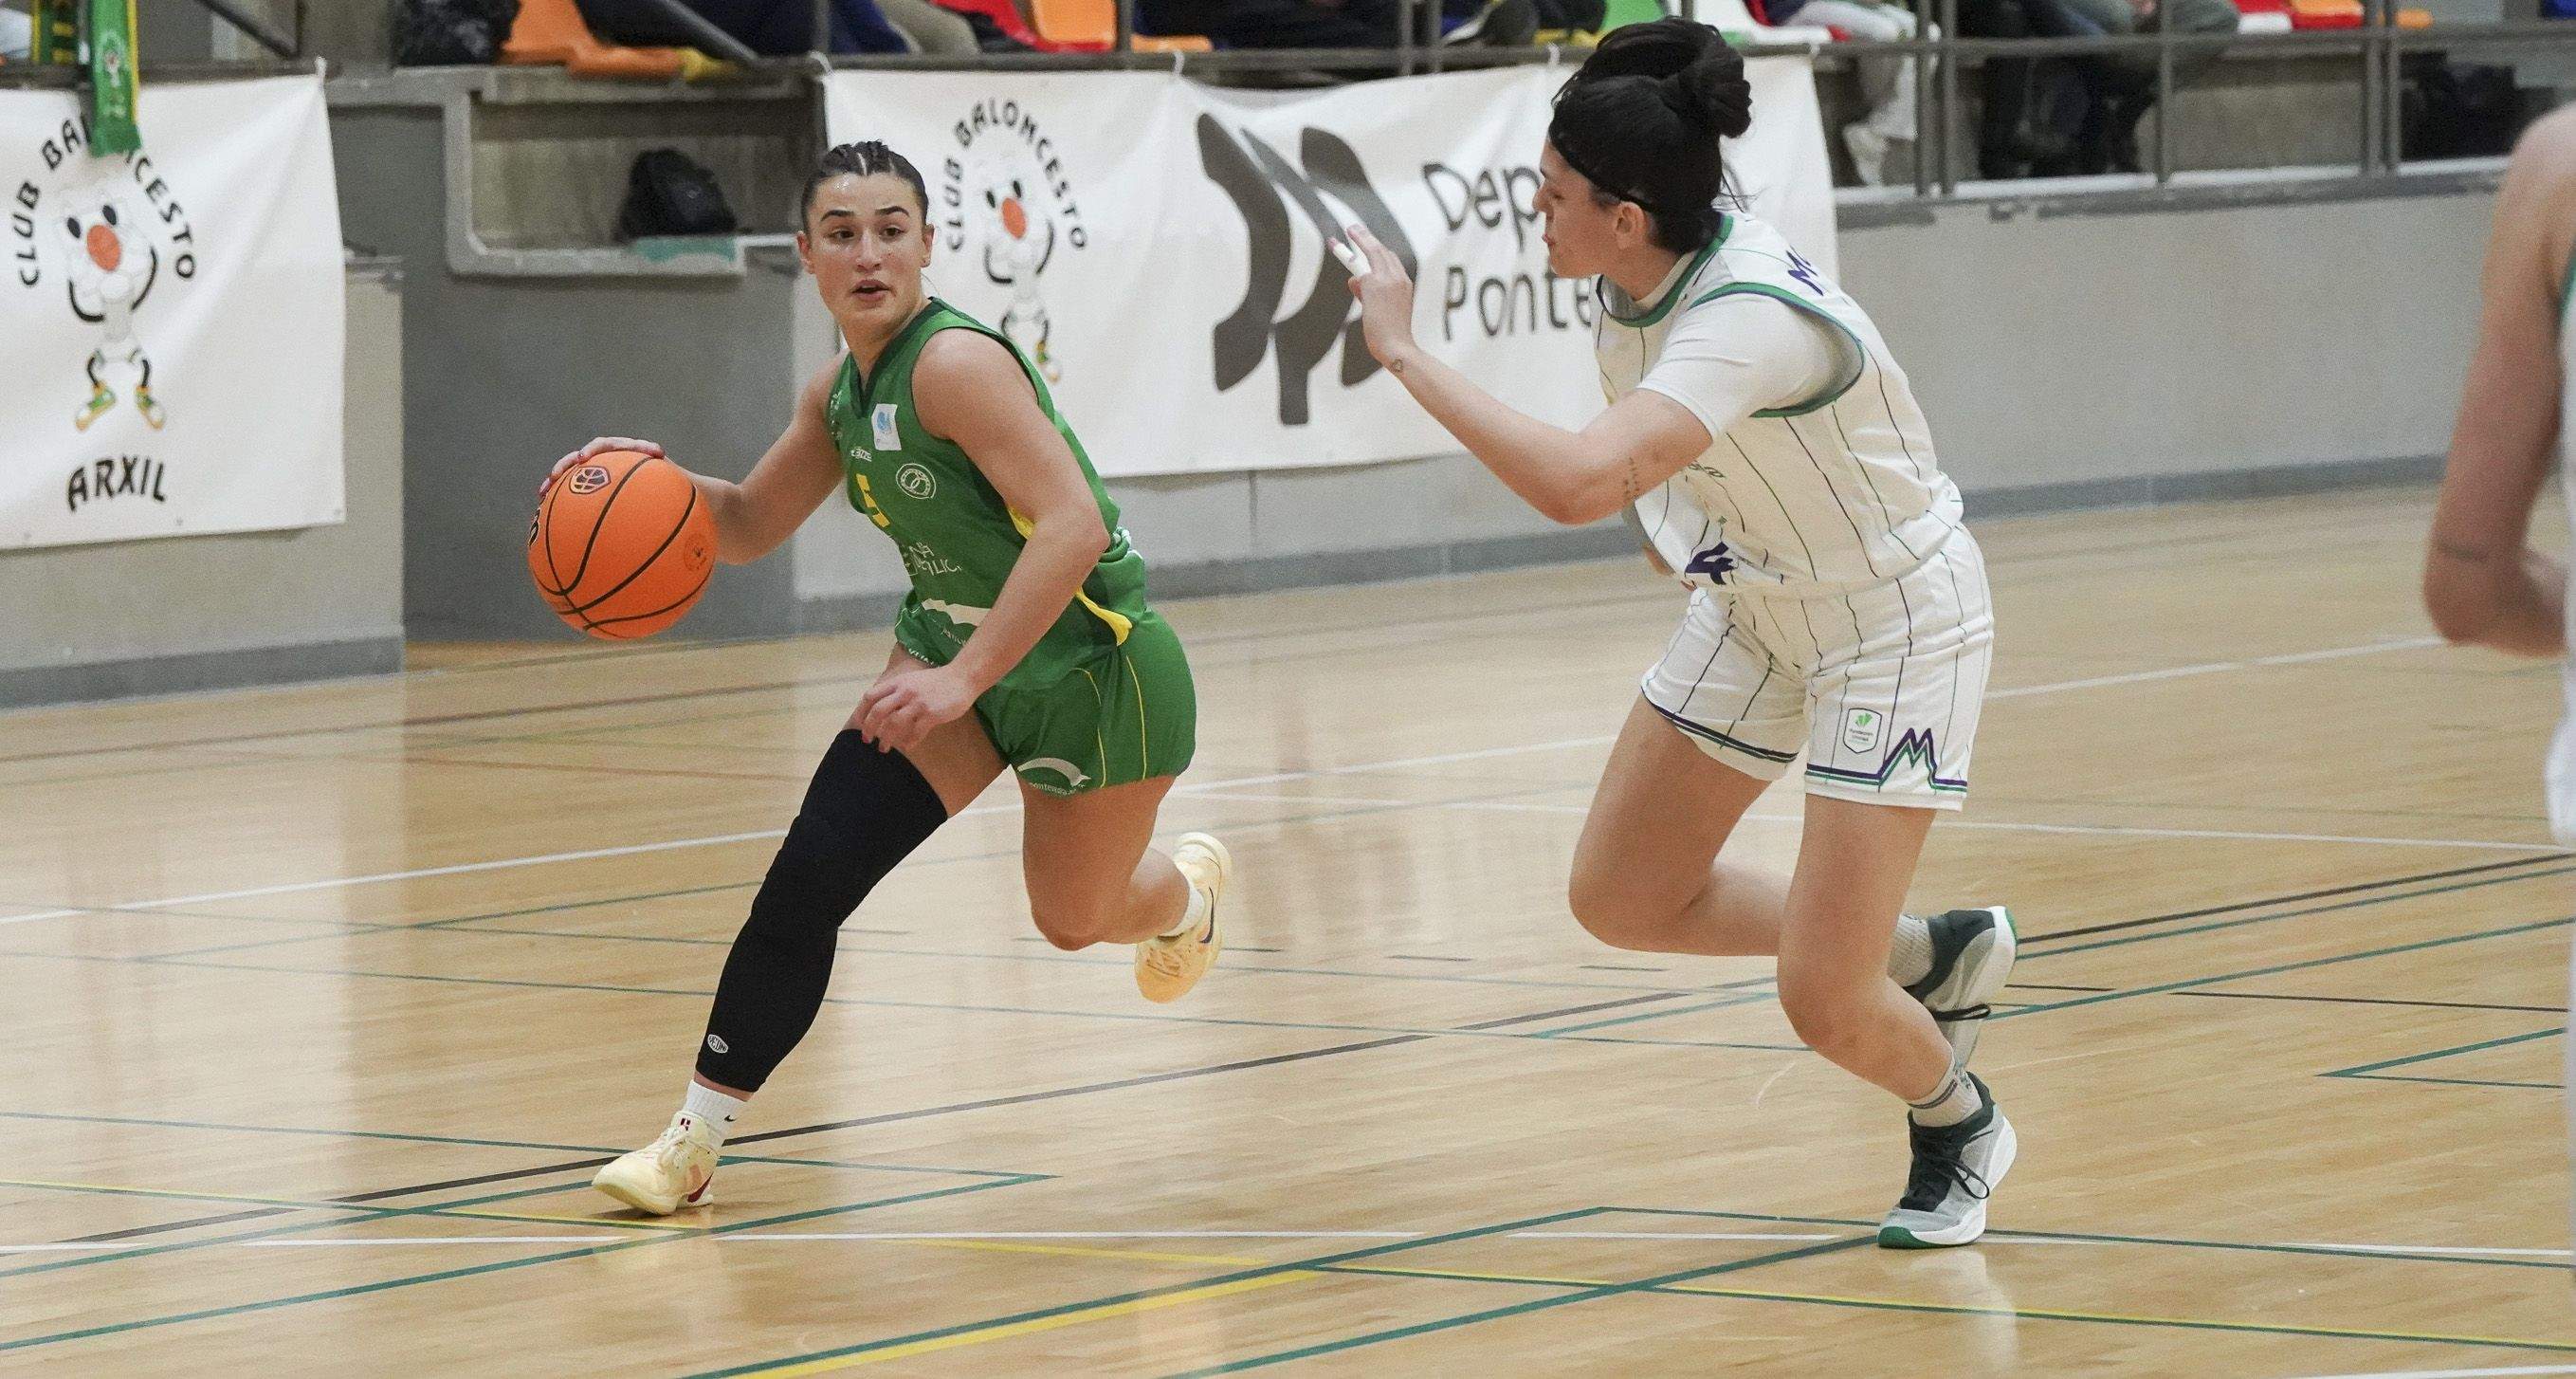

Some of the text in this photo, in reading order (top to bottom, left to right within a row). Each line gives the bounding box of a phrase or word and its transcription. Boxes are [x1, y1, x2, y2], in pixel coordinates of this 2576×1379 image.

[12, 114, 196, 287] CLUB BALCESTO
[943, 97, 1088, 252] CLUB BALONCESTO
[67, 455, 166, 512] ARXIL
